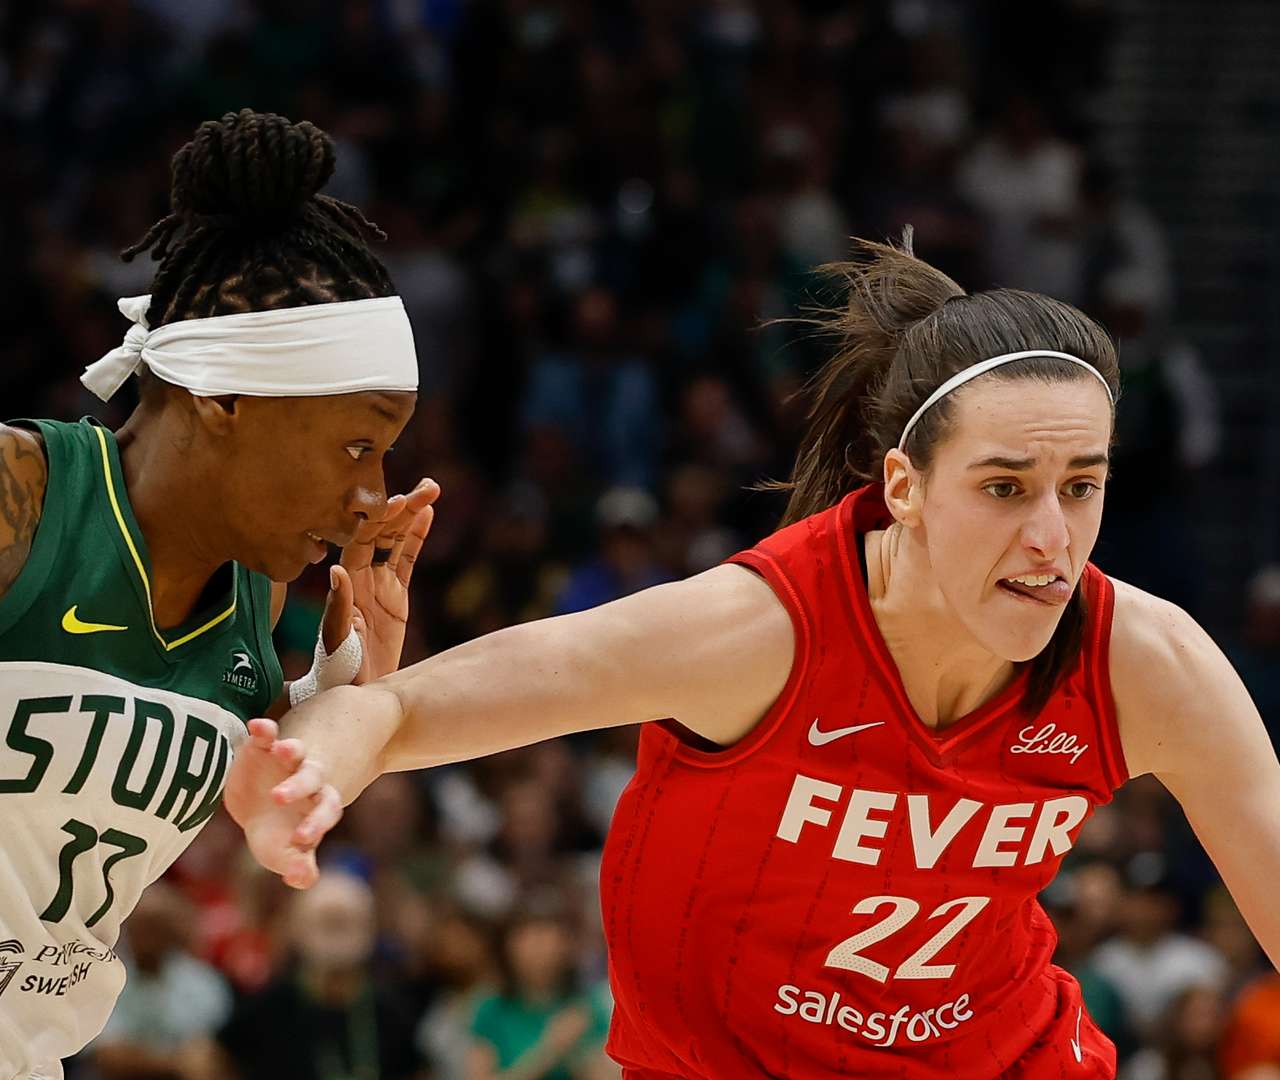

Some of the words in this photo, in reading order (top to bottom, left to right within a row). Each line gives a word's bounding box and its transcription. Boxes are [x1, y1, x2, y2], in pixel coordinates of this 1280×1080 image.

[1009, 722, 1089, 764] Lilly
[776, 773, 1090, 869] FEVER
[823, 895, 991, 984] 22
[774, 983, 974, 1047] salesforce
